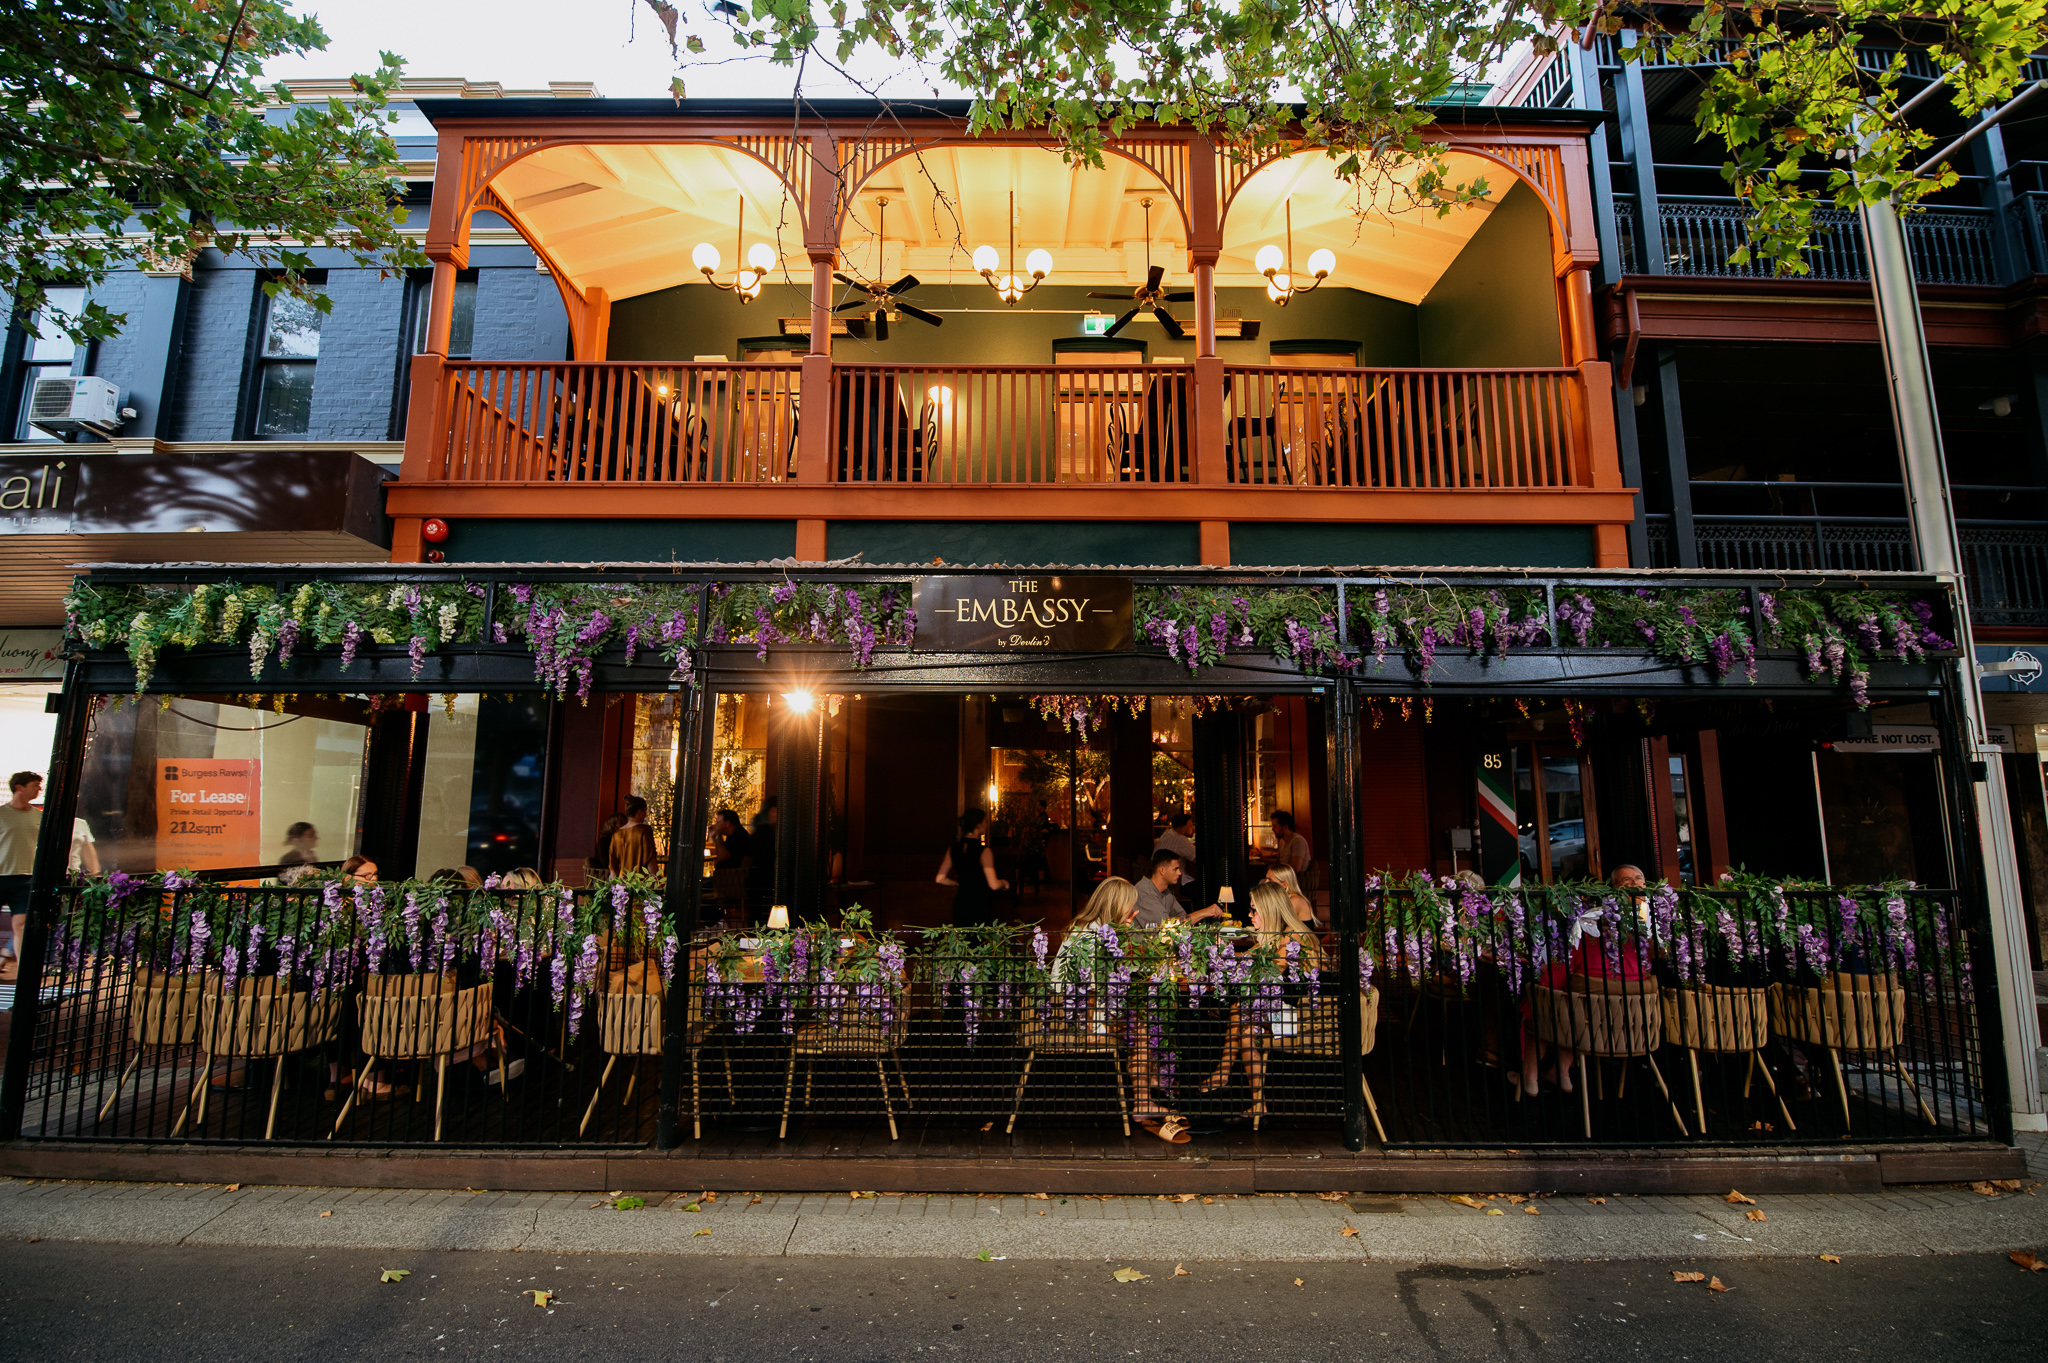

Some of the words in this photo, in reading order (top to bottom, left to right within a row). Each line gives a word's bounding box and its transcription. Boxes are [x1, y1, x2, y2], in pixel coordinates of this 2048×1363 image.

[0, 461, 66, 510] ali
[0, 517, 58, 526] ELLERY
[1008, 580, 1038, 593] THE
[956, 598, 1090, 628] EMBASSY
[998, 638, 1008, 648] by
[1881, 734, 1903, 743] NOT
[1906, 735, 1935, 744] LOST.
[1987, 735, 2009, 744] ERE.
[1484, 754, 1502, 768] 85
[181, 768, 218, 779] Burgess
[219, 768, 253, 777] Rawso
[170, 789, 196, 803] For
[199, 789, 245, 803] Lease
[213, 808, 254, 816] Opportuny
